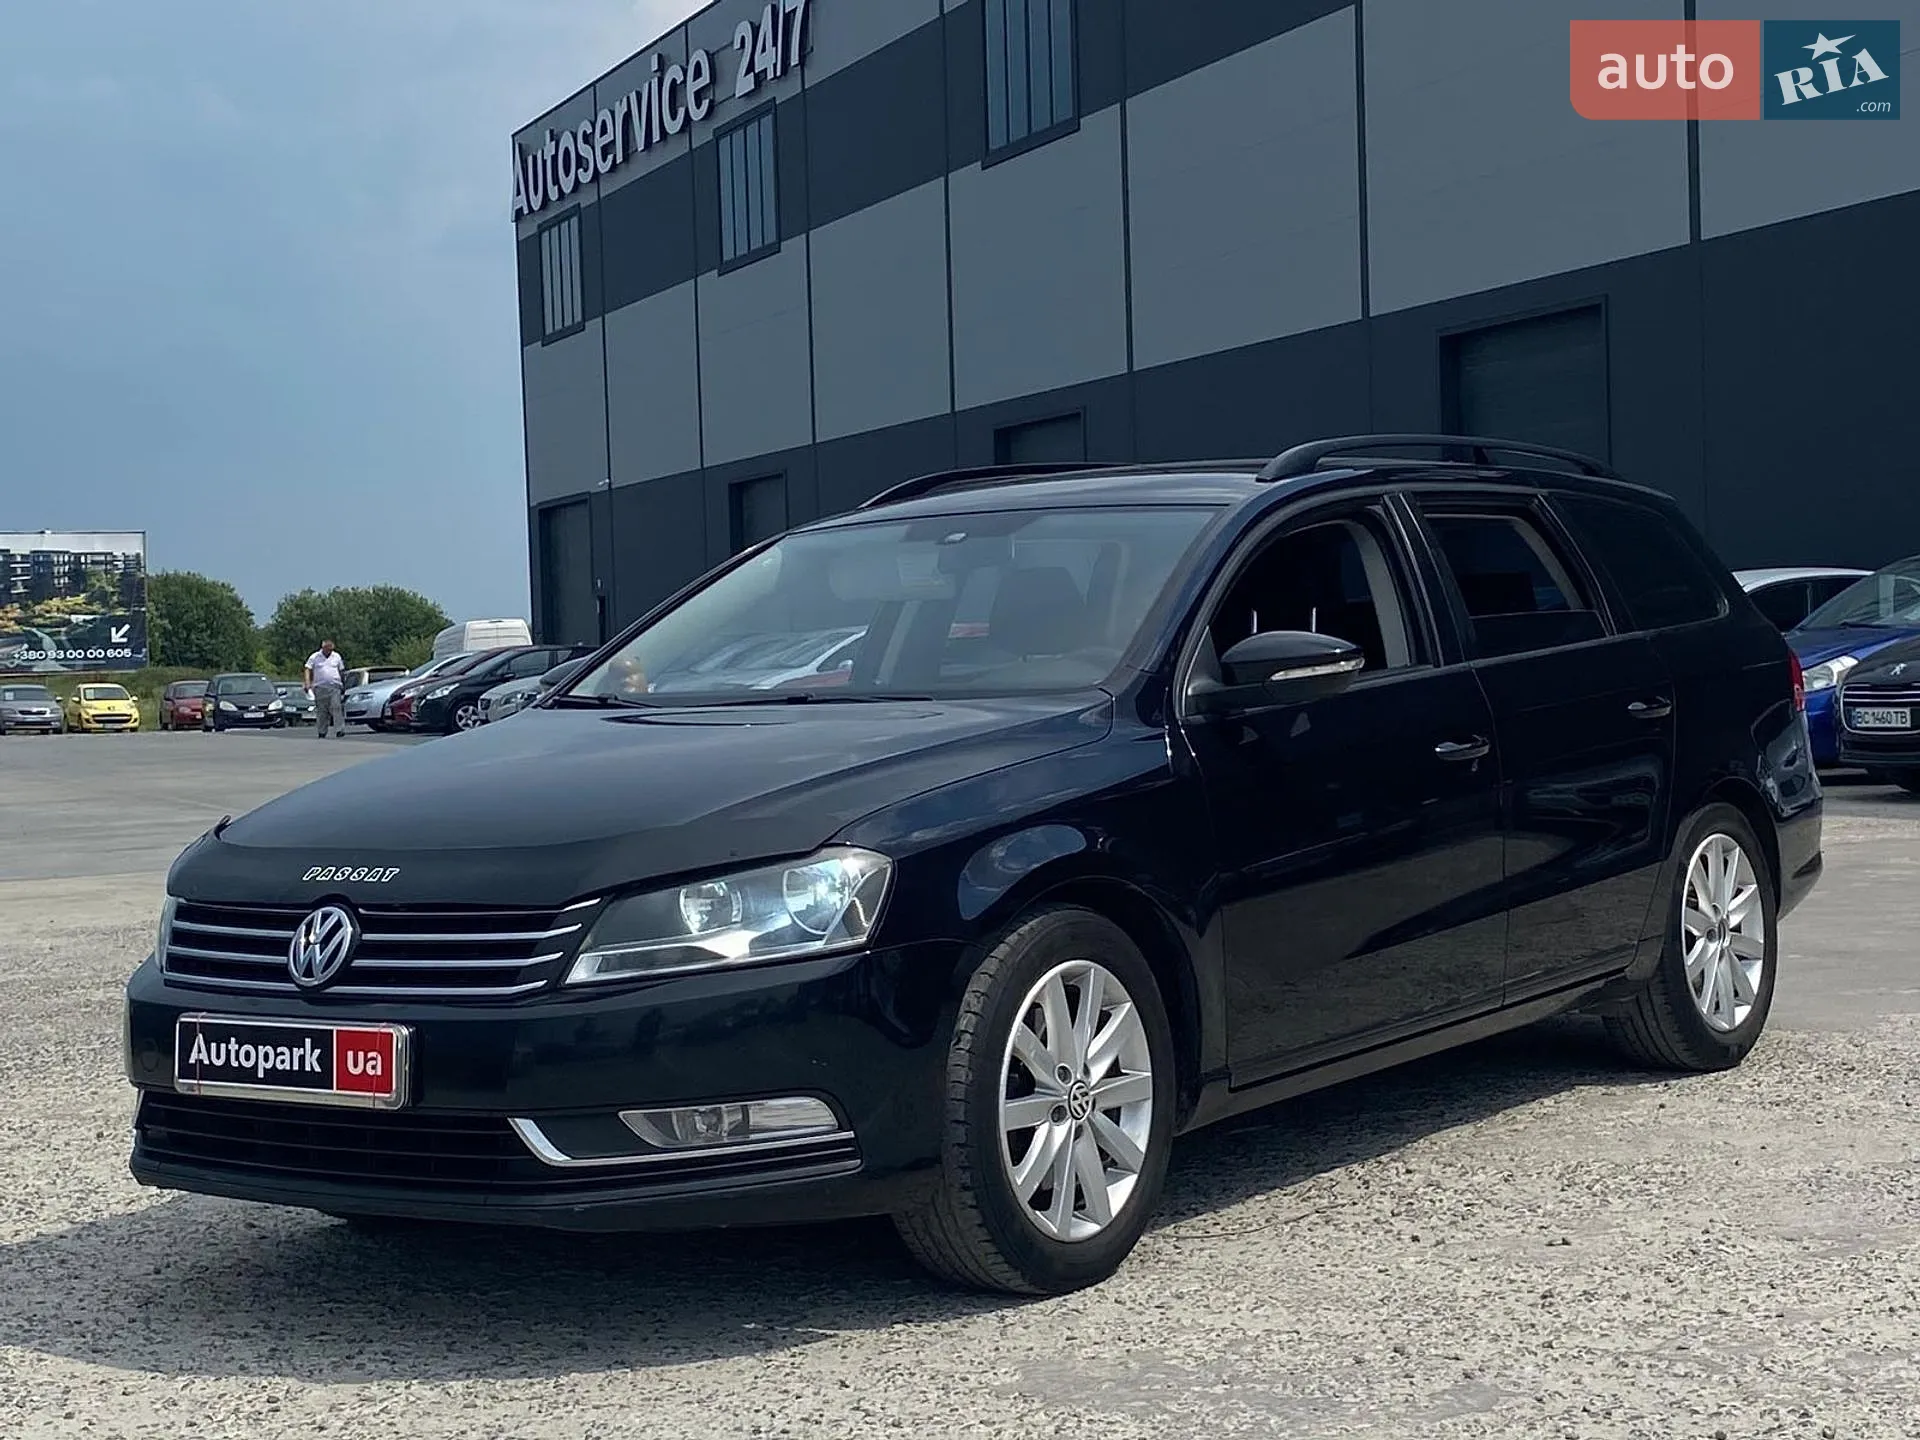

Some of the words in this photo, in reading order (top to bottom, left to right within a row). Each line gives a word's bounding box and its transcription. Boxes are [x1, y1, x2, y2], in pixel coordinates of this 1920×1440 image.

[512, 48, 713, 216] Autoservice
[733, 0, 810, 99] 24/7
[13, 649, 46, 660] +380
[47, 649, 65, 660] 93
[66, 649, 85, 659] 00
[86, 648, 105, 659] 00
[106, 648, 132, 658] 605
[302, 866, 400, 883] PASSAT
[188, 1032, 322, 1079] Autopark
[345, 1049, 383, 1077] ua
